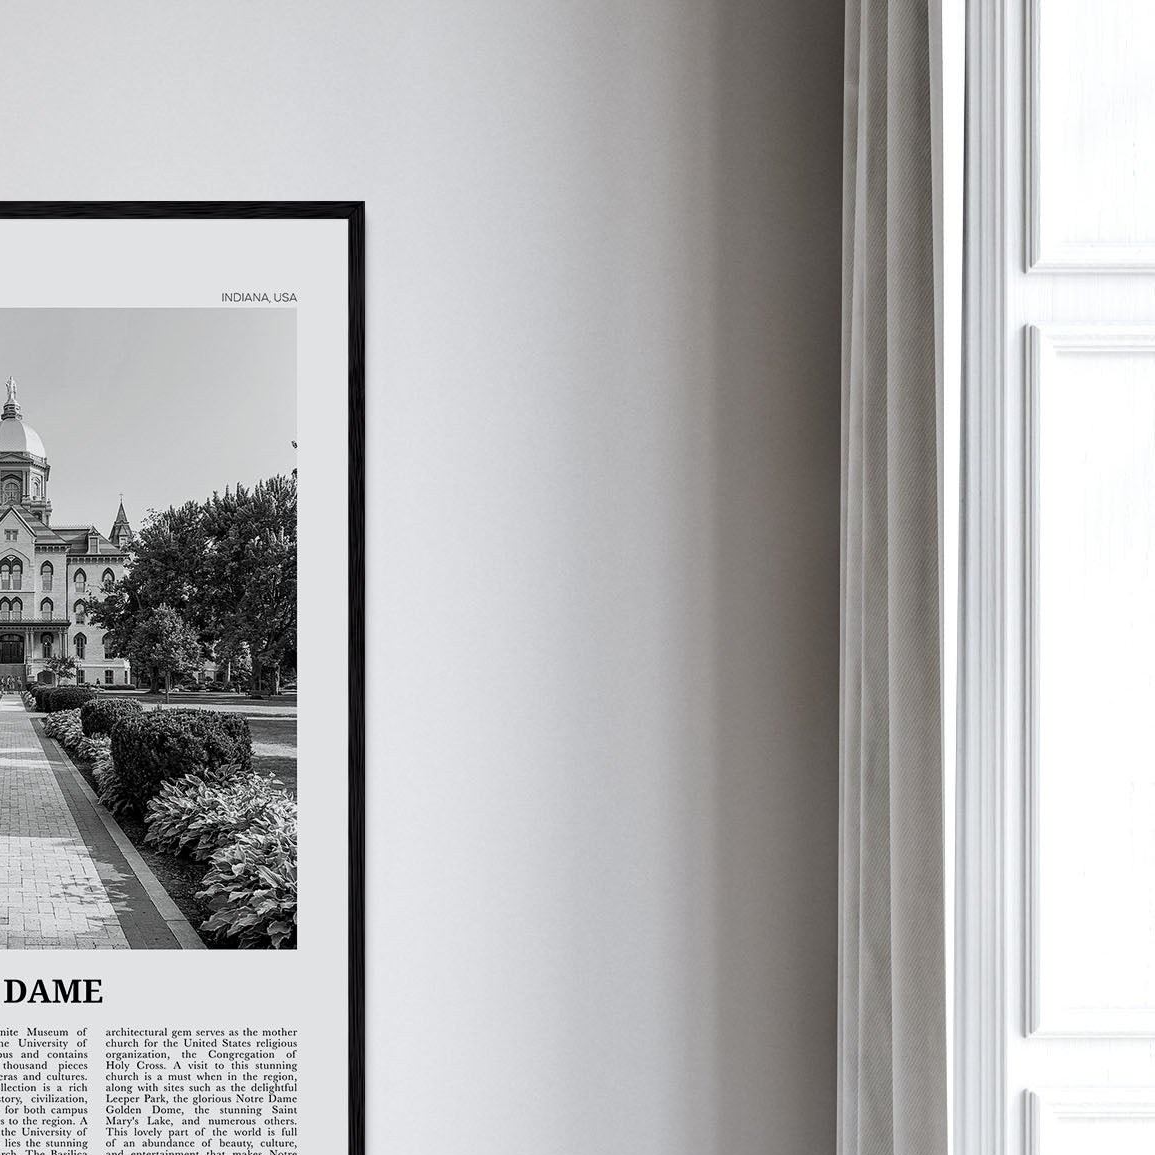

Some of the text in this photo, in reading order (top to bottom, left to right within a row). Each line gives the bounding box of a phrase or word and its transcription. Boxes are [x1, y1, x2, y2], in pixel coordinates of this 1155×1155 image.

[222, 293, 297, 303] INDIANA, USA
[4, 979, 103, 1003] DAME
[27, 1027, 68, 1036] Museum
[77, 1027, 88, 1036] of
[106, 1027, 167, 1036] architectural
[172, 1030, 191, 1039] gem
[243, 1027, 258, 1036] the
[263, 1027, 297, 1036] mother
[19, 1038, 68, 1050] University
[77, 1038, 88, 1047] of
[21, 1050, 39, 1059] and
[47, 1050, 88, 1059] contains
[106, 1050, 297, 1061] organization, the Congregation of
[3, 1061, 47, 1070] thousand
[59, 1061, 88, 1072] pieces
[106, 1061, 297, 1072] Holy Cross. A visit to this stunning
[23, 1072, 41, 1081] and
[47, 1072, 87, 1081] cultures.
[43, 1083, 50, 1092] is
[69, 1083, 87, 1092] rich
[106, 1083, 133, 1094] along
[138, 1083, 158, 1092] with
[164, 1083, 184, 1092] sites
[189, 1083, 210, 1092] such
[231, 1083, 246, 1092] the
[251, 1083, 297, 1094] delightful
[5, 1105, 19, 1114] for
[24, 1105, 45, 1114] both
[51, 1107, 88, 1116] campus
[106, 1105, 297, 1116] Golden Dome, the stunning Saint
[106, 1116, 139, 1128] Mary's
[148, 1116, 173, 1127] Lake,
[182, 1116, 200, 1125] and
[264, 1116, 297, 1125] others.
[1, 1127, 16, 1136] the
[22, 1127, 71, 1139] University
[77, 1127, 88, 1136] of
[106, 1139, 117, 1147] of
[142, 1139, 195, 1147] abundance
[202, 1139, 213, 1147] of
[220, 1139, 253, 1150] beauty,
[260, 1139, 297, 1149] culture,
